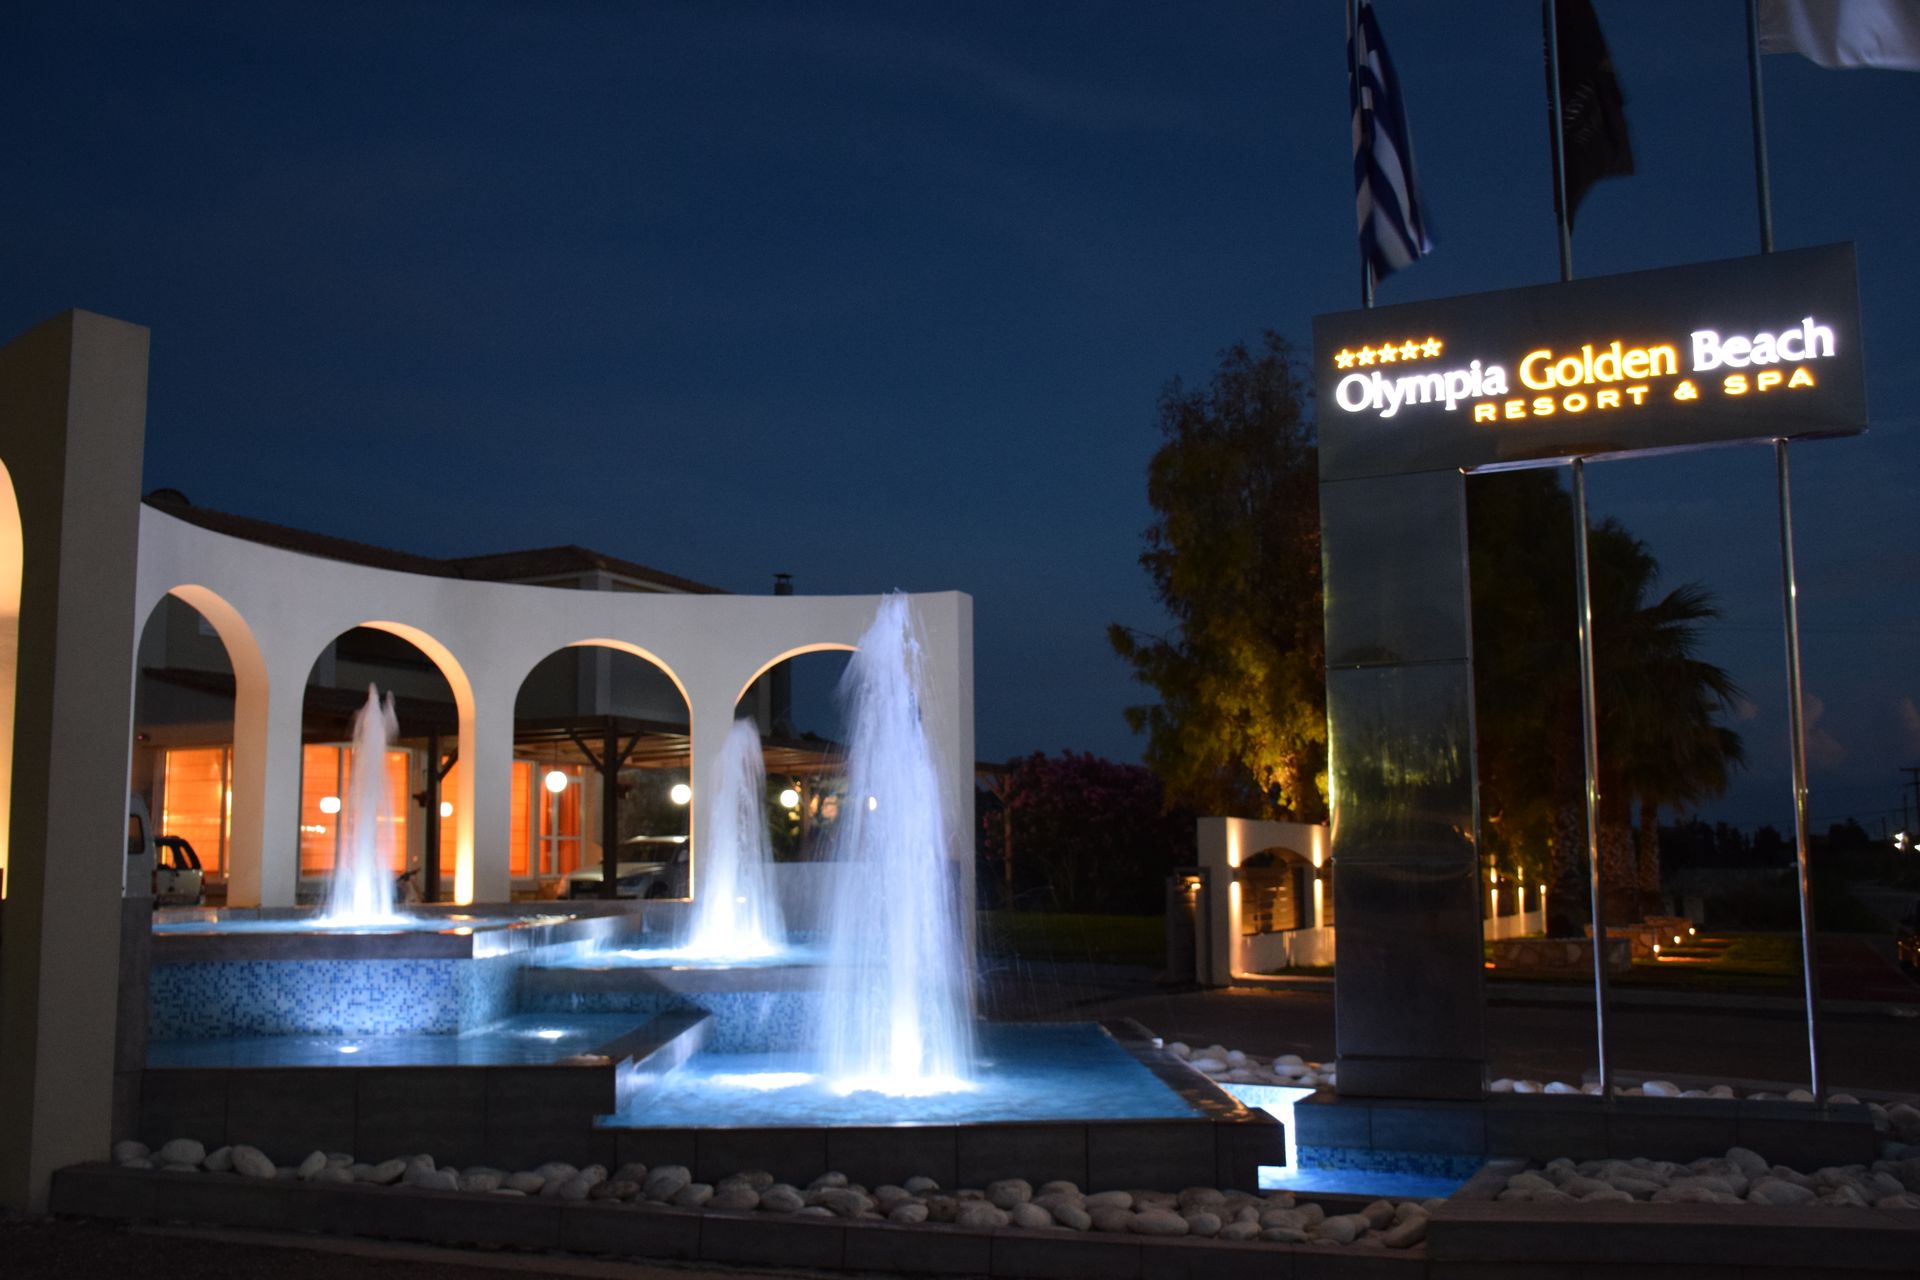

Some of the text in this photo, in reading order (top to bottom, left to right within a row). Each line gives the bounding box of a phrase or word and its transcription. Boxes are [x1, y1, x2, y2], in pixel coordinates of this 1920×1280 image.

[1335, 317, 1835, 418] Olympia Golden Beach
[1474, 367, 1814, 422] RESORT & SPA
